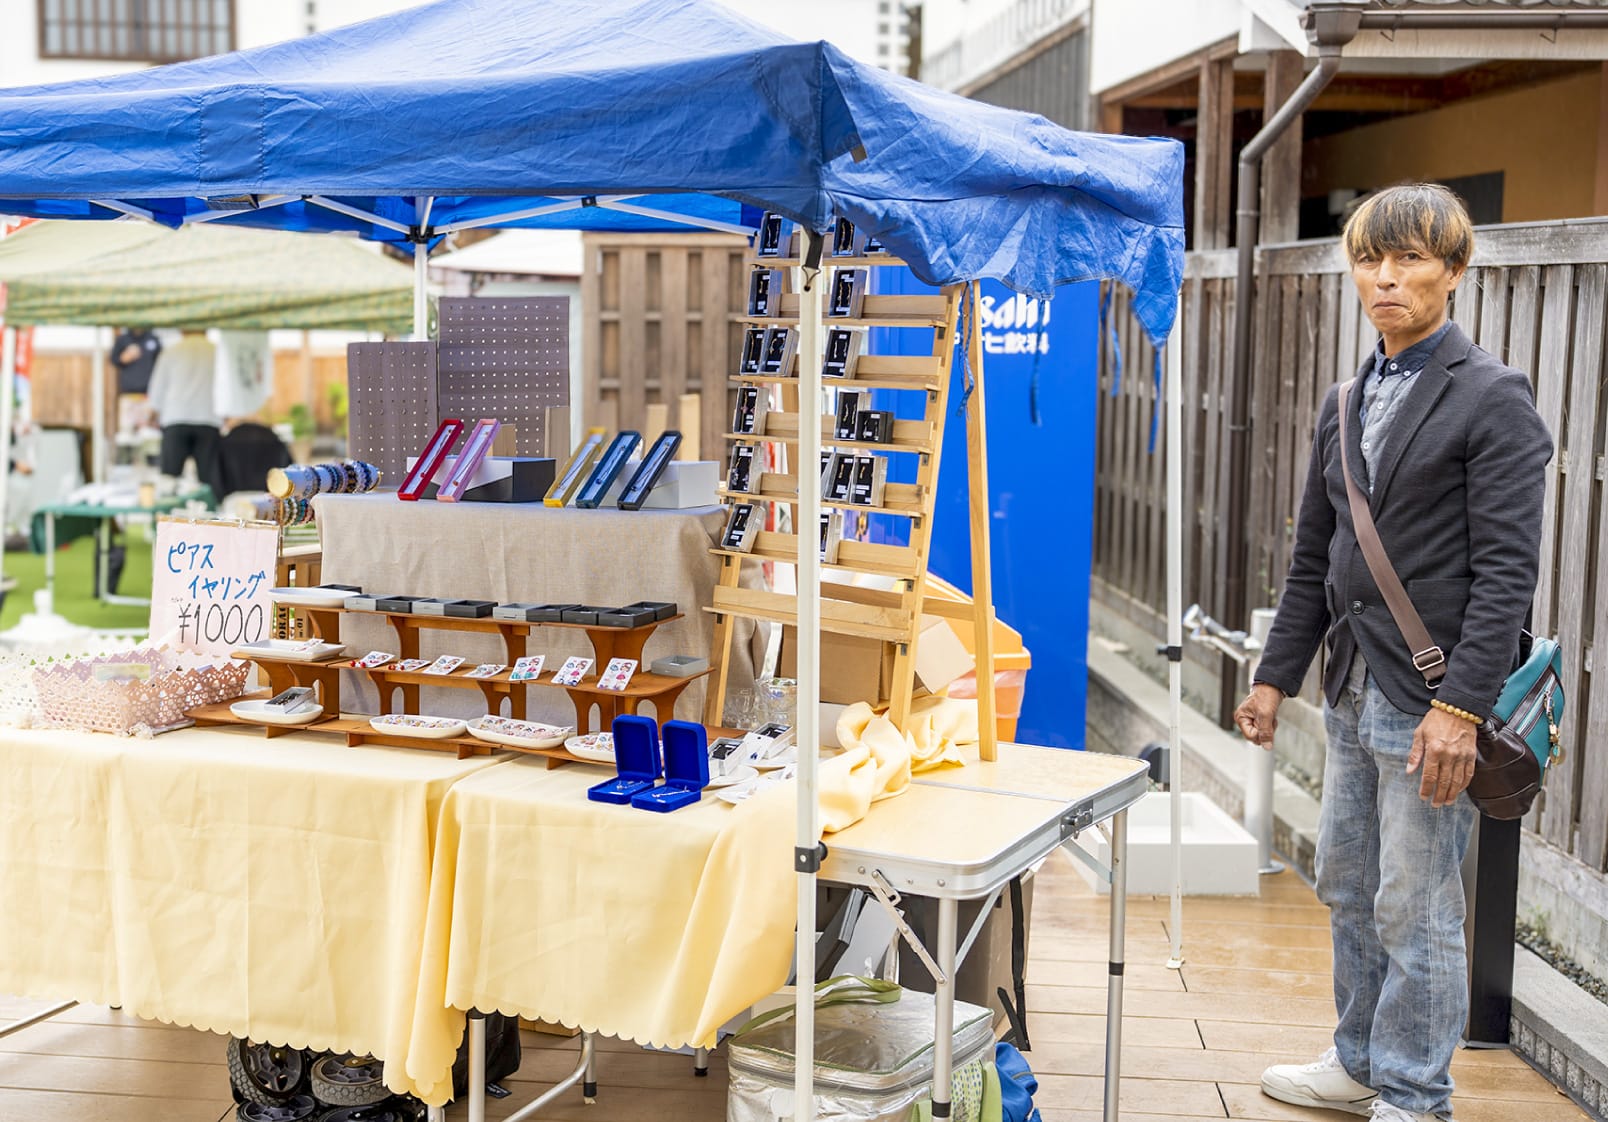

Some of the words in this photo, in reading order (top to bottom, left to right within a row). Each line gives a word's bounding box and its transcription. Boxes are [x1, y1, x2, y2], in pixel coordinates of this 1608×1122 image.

[167, 541, 214, 573] ピアス
[188, 570, 266, 600] イヤリング
[178, 603, 263, 645] ¥1000
